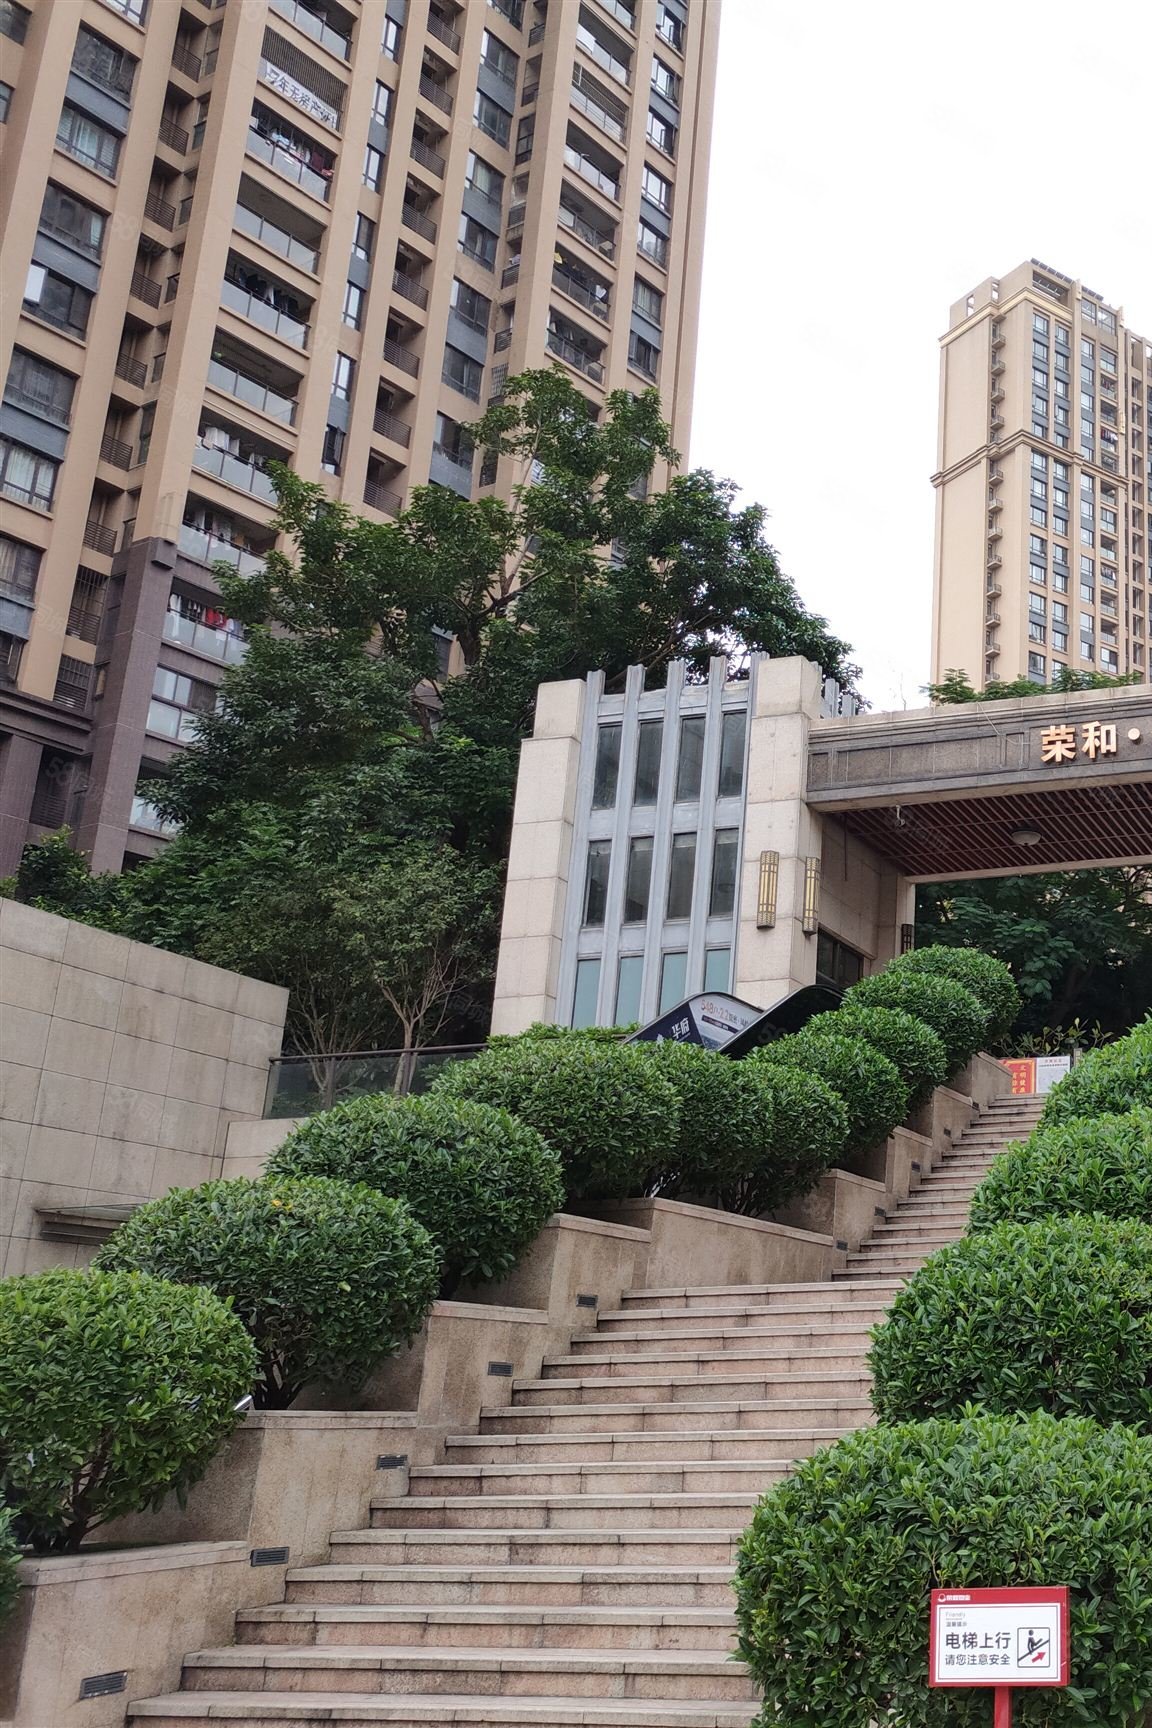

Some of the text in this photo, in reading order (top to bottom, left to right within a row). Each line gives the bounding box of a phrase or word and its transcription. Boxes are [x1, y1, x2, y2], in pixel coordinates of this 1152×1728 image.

[945, 1632, 1012, 1650] 电梯上行
[945, 1653, 1011, 1666] 请您注意安全
